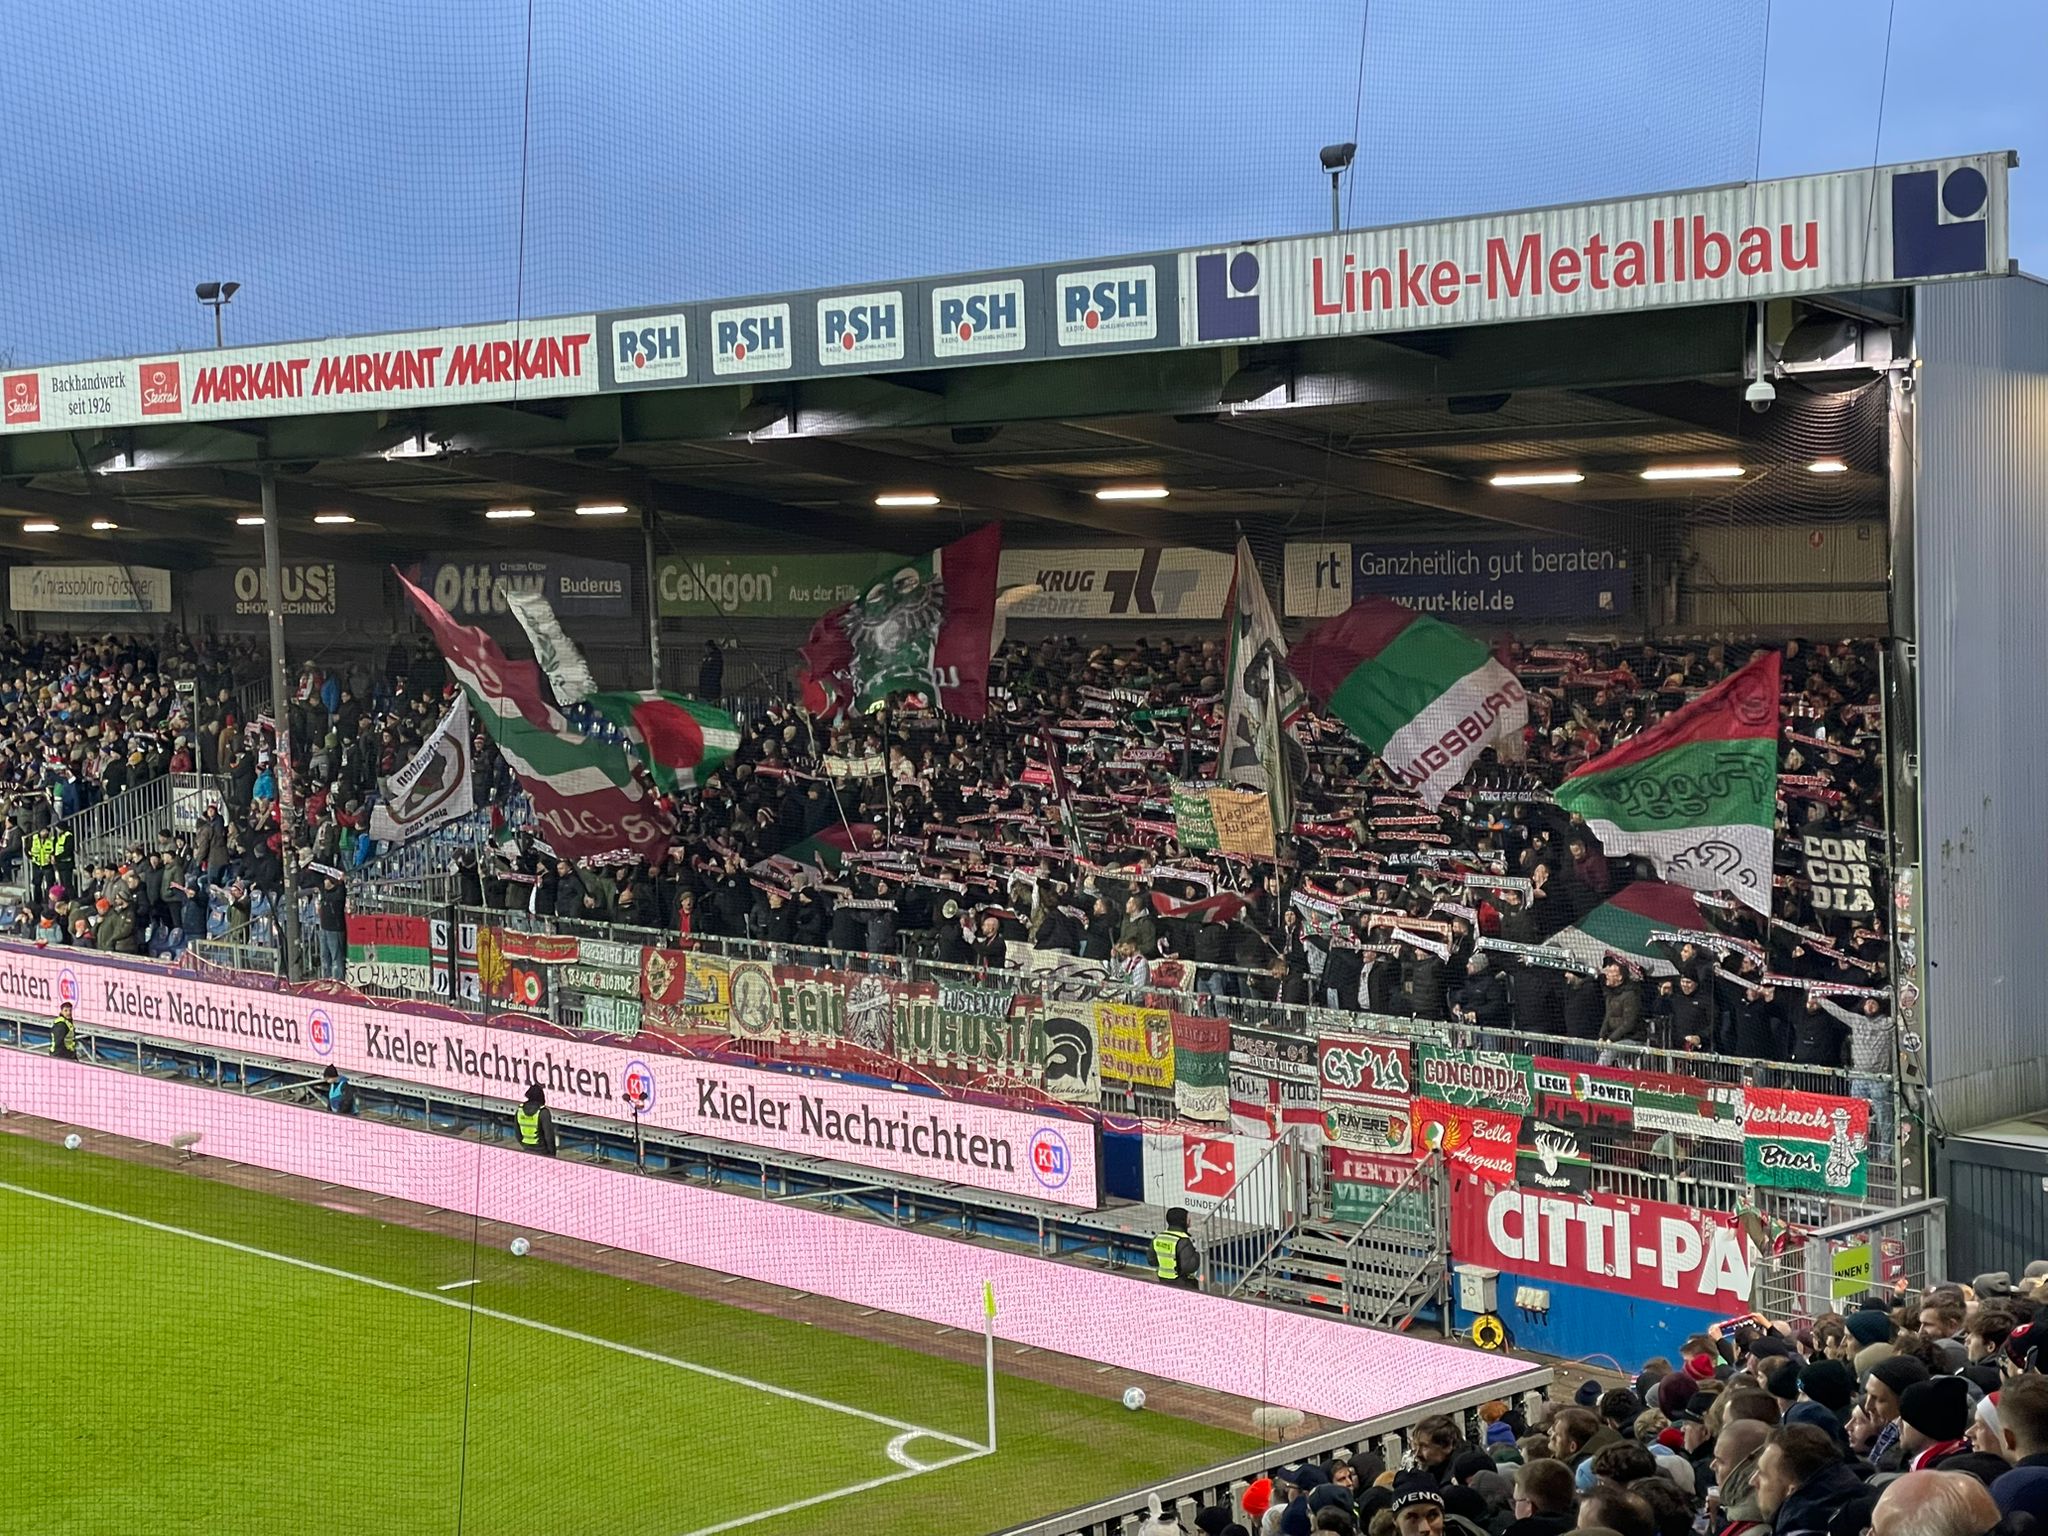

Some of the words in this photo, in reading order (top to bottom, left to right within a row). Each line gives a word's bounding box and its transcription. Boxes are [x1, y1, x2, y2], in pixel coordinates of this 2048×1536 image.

[1312, 213, 1820, 317] Linke-Metallbau
[940, 292, 1017, 336] RSH
[1065, 279, 1148, 323] RSH
[718, 316, 783, 353] RSH
[825, 304, 895, 344] RSH
[619, 325, 680, 364] RSH
[52, 371, 126, 393] Backhandwerk
[192, 358, 311, 404] MARKANT
[312, 347, 443, 396] MARKANT
[445, 333, 591, 386] MARKANT
[68, 402, 86, 416] seit
[88, 398, 111, 414] 1926
[1360, 551, 1480, 577] Ganzheitlich
[1489, 554, 1523, 581] gut
[41, 572, 104, 596] Inkassobüro
[235, 566, 327, 601] OUS
[561, 577, 622, 593] Buderus
[660, 564, 772, 612] Cellagon
[789, 586, 812, 601] Aus
[816, 584, 835, 600] der
[1036, 570, 1096, 592] KRUG
[1804, 835, 1865, 862] CON
[1807, 859, 1871, 888] COR
[1811, 886, 1875, 912] DIA
[436, 924, 446, 946] S
[462, 926, 473, 950] U
[347, 965, 426, 988] SCHWABEN
[465, 975, 473, 997] 7
[104, 980, 163, 1020] Kieler
[168, 991, 300, 1044] Nachrichten
[1102, 1008, 1137, 1029] Frei
[894, 999, 1045, 1065] AUGUSTA
[365, 1023, 438, 1066] Kieler
[443, 1035, 612, 1100] Nachrichten
[1102, 1054, 1164, 1080] Bayern
[1424, 1058, 1526, 1096] CONCORDIA
[1539, 1075, 1568, 1091] LECH
[1591, 1084, 1632, 1104] POWER
[697, 1077, 792, 1131] Kieler
[800, 1095, 1015, 1173] Nachrichten
[1338, 1113, 1389, 1133] RAVERS
[1472, 1119, 1513, 1144] Bella
[1451, 1146, 1514, 1173] Augusta
[1760, 1145, 1821, 1172] Bros.
[1864, 1263, 1870, 1274] 9
